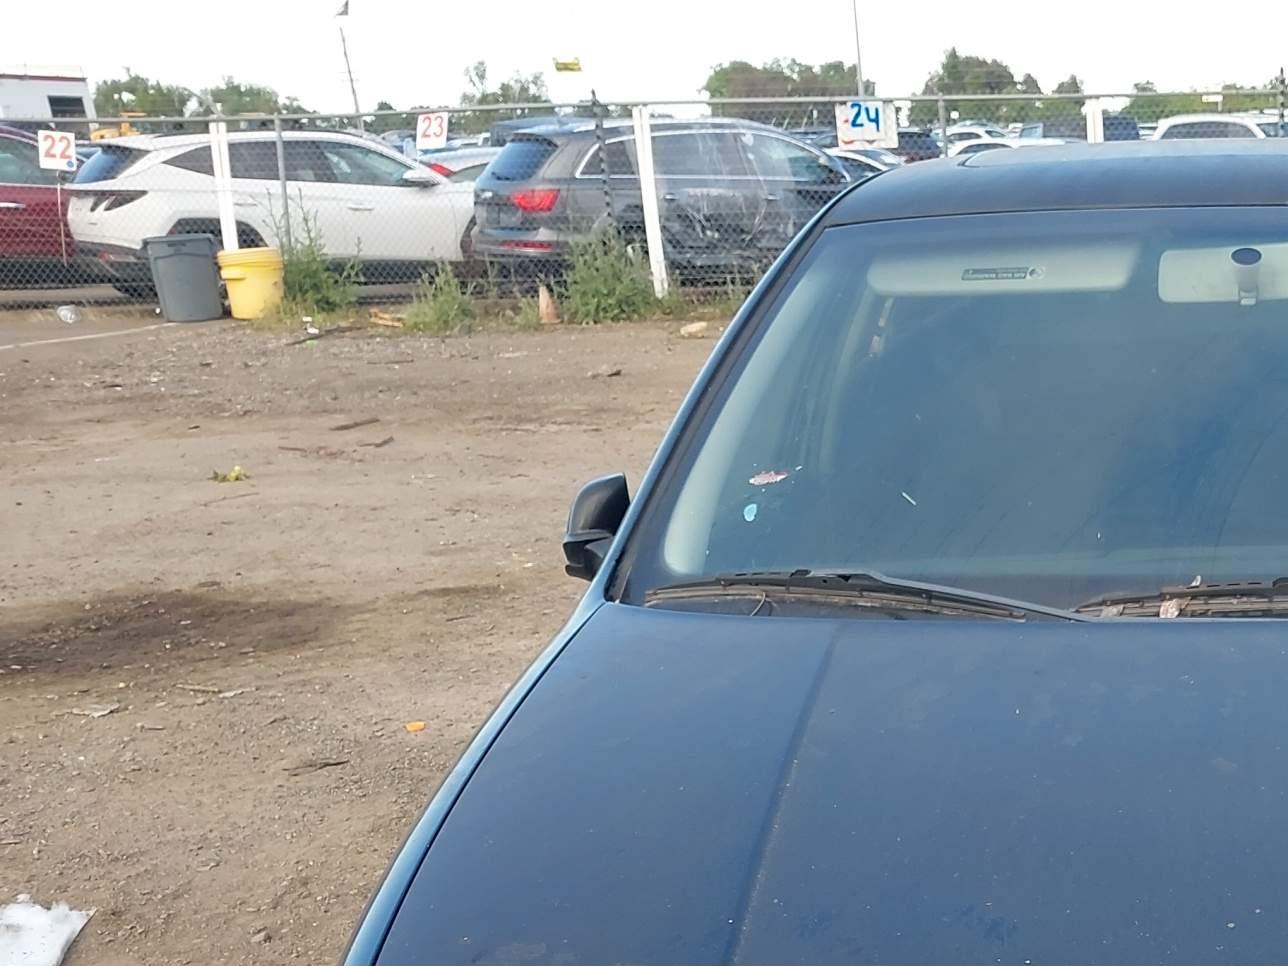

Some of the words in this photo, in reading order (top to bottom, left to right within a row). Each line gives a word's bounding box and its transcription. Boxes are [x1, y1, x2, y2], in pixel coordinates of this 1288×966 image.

[421, 115, 444, 138] 23
[850, 103, 880, 132] 24
[43, 134, 72, 159] 22
